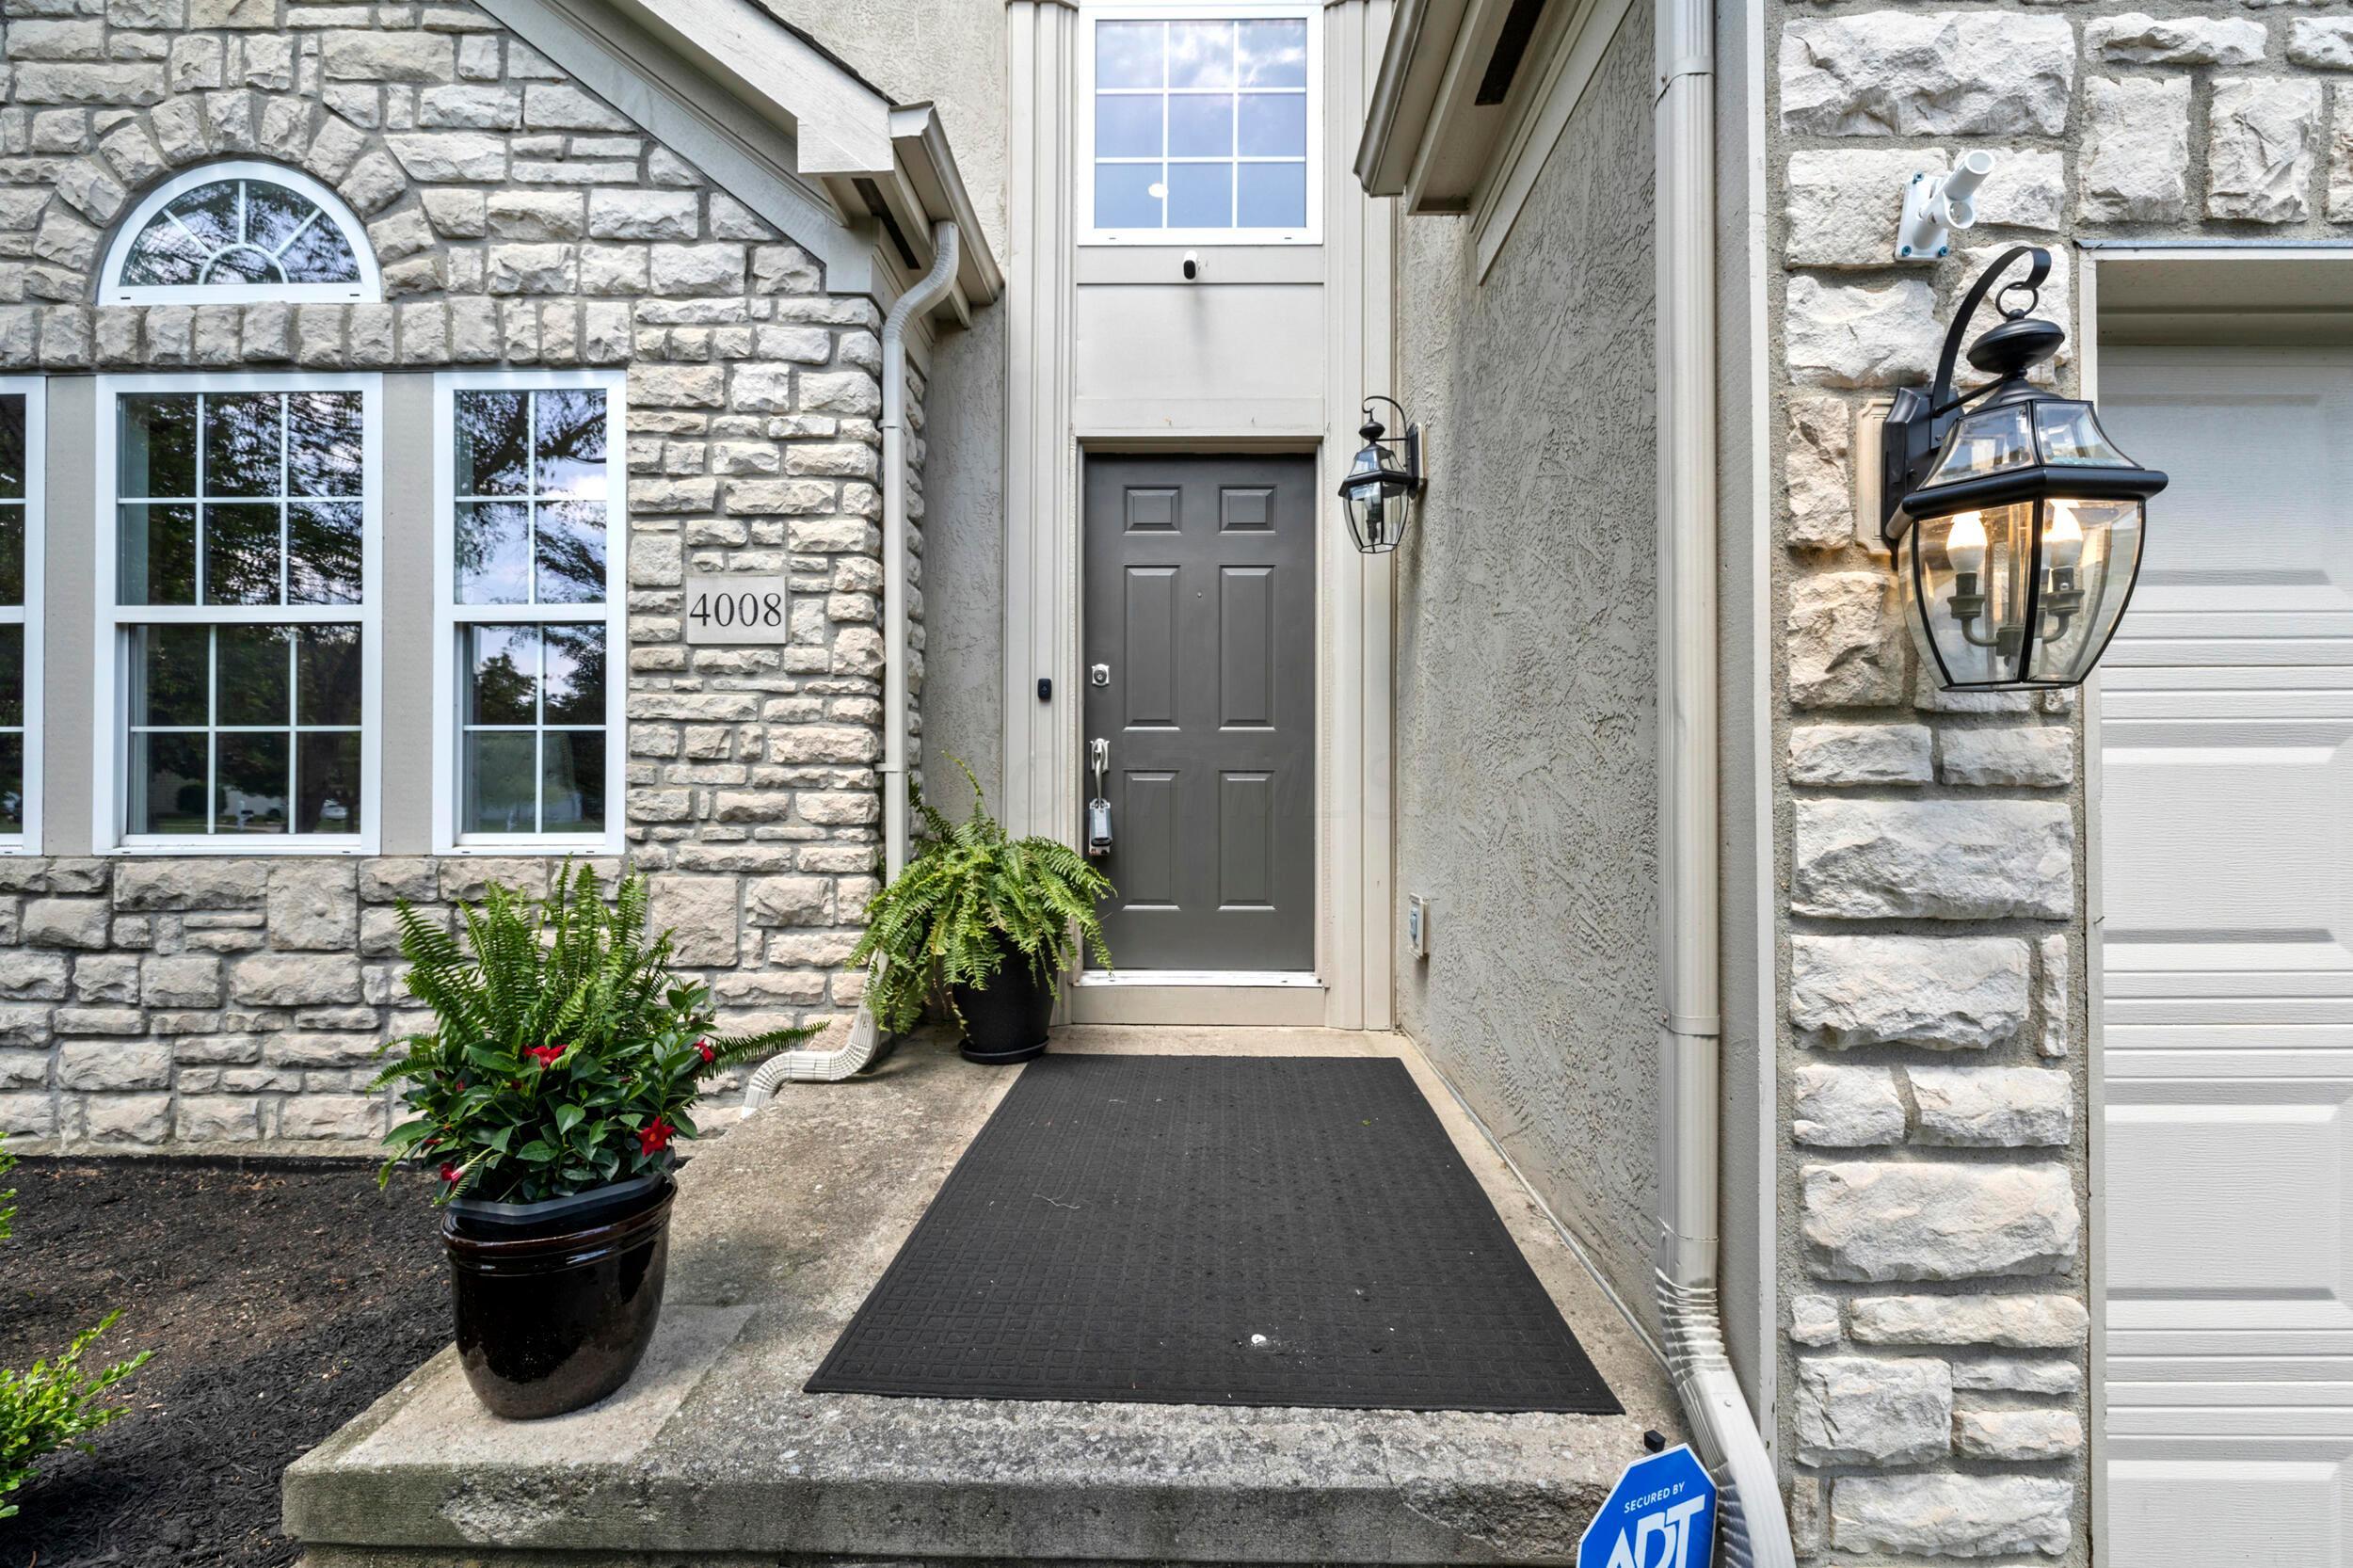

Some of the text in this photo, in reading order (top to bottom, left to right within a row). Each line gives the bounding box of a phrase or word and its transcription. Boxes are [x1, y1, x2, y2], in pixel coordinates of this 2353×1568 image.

[689, 593, 782, 627] 4008
[1624, 1480, 1686, 1514] SECURED BY
